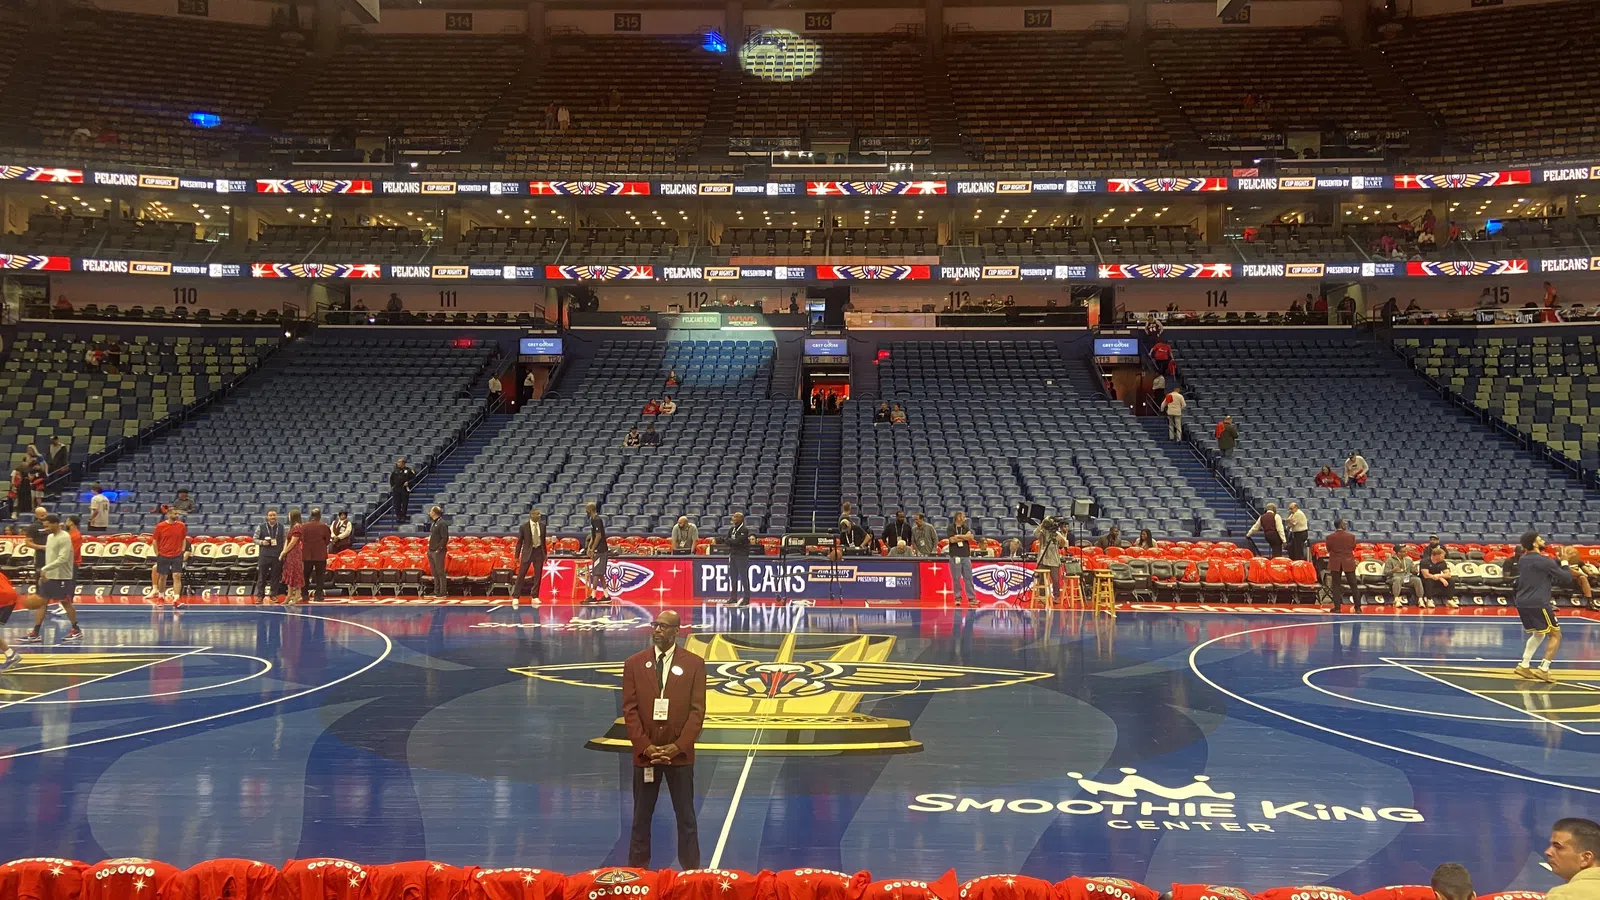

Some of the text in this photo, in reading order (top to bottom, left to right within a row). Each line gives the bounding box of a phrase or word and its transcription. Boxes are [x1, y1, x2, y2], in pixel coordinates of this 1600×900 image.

[448, 16, 470, 28] 314
[617, 16, 639, 27] 315
[807, 15, 830, 27] 316
[1027, 13, 1049, 25] 317
[95, 172, 138, 186] PELICANS
[1543, 168, 1589, 182] PELICANS
[180, 180, 207, 190] PRESENTED
[383, 182, 420, 194] PELICANS
[660, 183, 697, 195] PELICANS
[957, 182, 995, 194] PELICANS
[1238, 178, 1277, 190] PELICANS
[1318, 180, 1343, 188] PRESENTED
[82, 259, 128, 273] PELICANS
[172, 266, 200, 274] PRESENTED
[1242, 265, 1284, 276] PELICANS
[1326, 266, 1353, 274] PRESENTED
[1541, 258, 1589, 272] PELICANS
[391, 266, 430, 278] PELICANS
[664, 268, 702, 280] PELICANS
[941, 268, 980, 279] PELICANS
[1020, 268, 1047, 276] PRESENTED
[176, 287, 200, 305] 110
[439, 290, 457, 307] 111
[687, 291, 709, 308] 112
[1205, 290, 1229, 308] 114
[18, 544, 29, 555] G
[84, 543, 97, 555] G
[108, 543, 121, 555] G
[132, 543, 144, 555] G
[200, 544, 213, 556] G
[222, 544, 234, 555] G
[245, 544, 257, 556] G
[1364, 562, 1376, 574] G
[1462, 564, 1474, 576] G
[1485, 565, 1498, 578] G
[28, 585, 37, 594] G
[74, 585, 83, 595] G
[94, 586, 105, 596] G
[120, 586, 130, 595] G
[236, 586, 246, 596] G
[1374, 596, 1385, 604] G
[1472, 596, 1484, 606] G
[1496, 596, 1508, 606] G
[1570, 597, 1582, 607] G
[907, 793, 1237, 818] SMOOTHIE
[1106, 819, 1276, 834] CENTER
